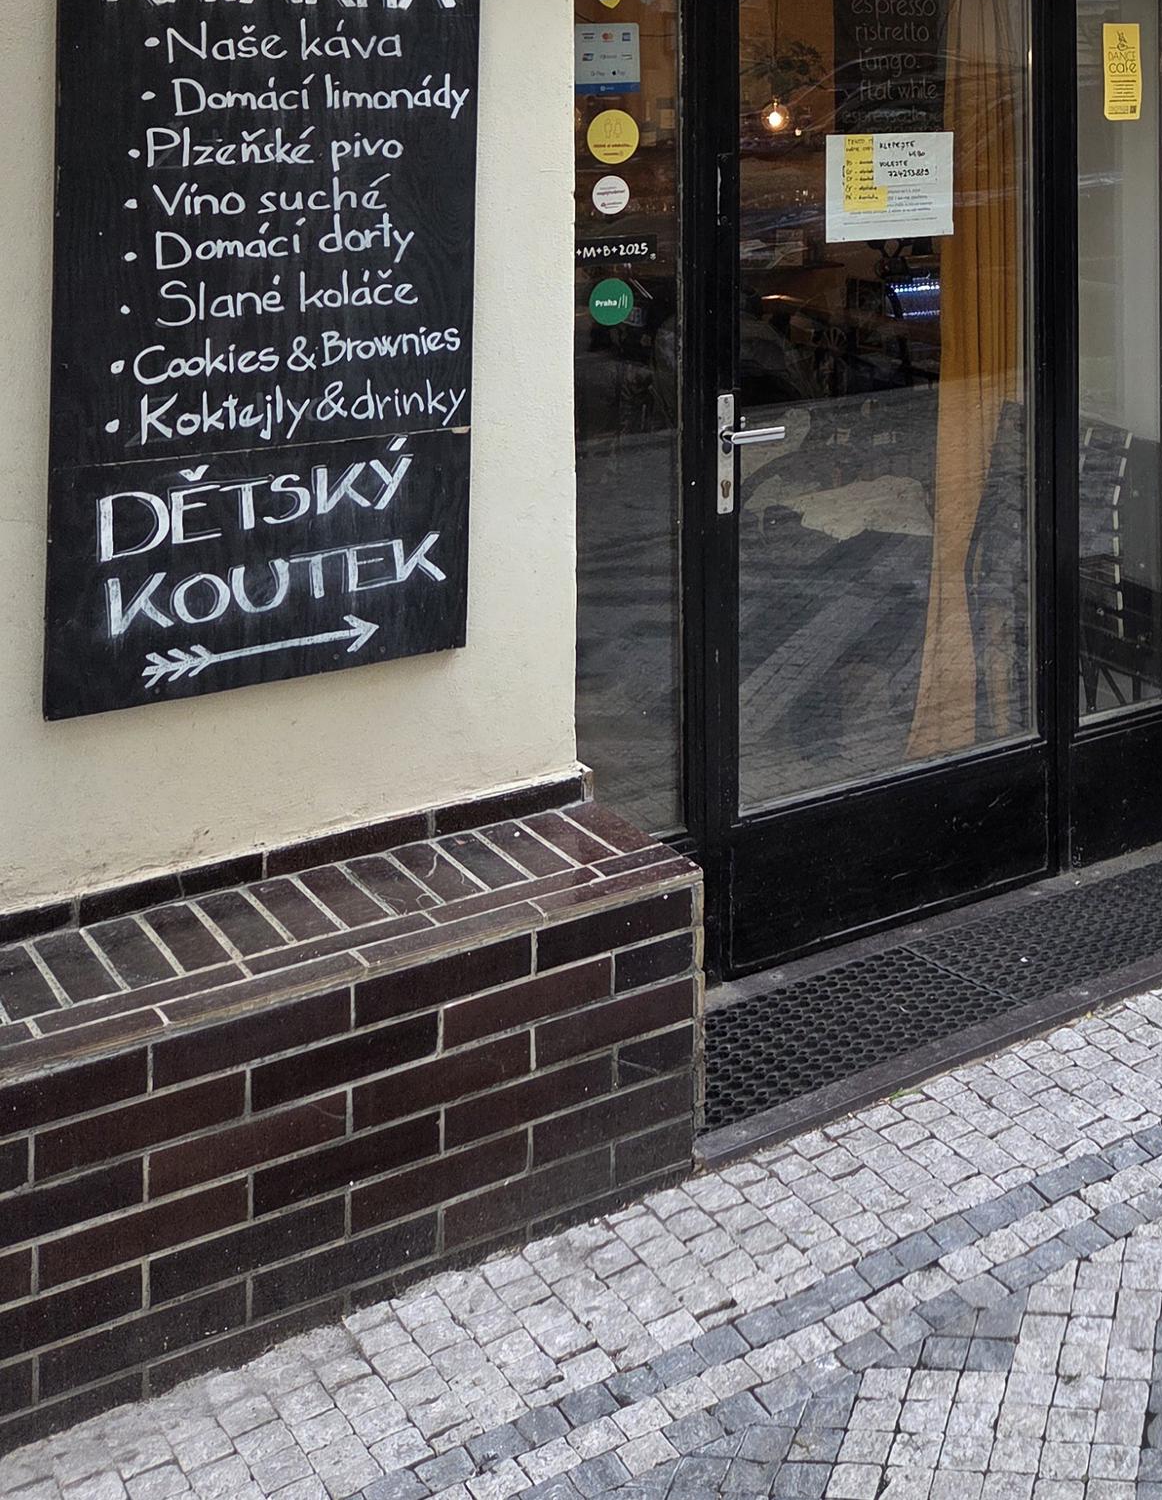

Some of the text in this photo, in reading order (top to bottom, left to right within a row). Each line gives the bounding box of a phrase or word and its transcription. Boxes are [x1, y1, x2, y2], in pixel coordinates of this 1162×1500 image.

[167, 19, 401, 63] Naše káva
[855, 22, 929, 42] ristretto
[171, 73, 470, 119] Domácí limonády
[899, 77, 938, 99] white
[146, 126, 404, 171] Plzeňské pivo
[153, 173, 391, 216] Víno suché
[156, 212, 415, 270] Domácí dorty
[156, 269, 420, 327] Slané koláče
[595, 299, 617, 307] Praha
[133, 338, 280, 386] Cookies
[321, 326, 461, 368] Brownies
[140, 385, 310, 446] Koktejly
[97, 435, 414, 563] DĚTSKÝ
[104, 531, 447, 639] KOUTEK
